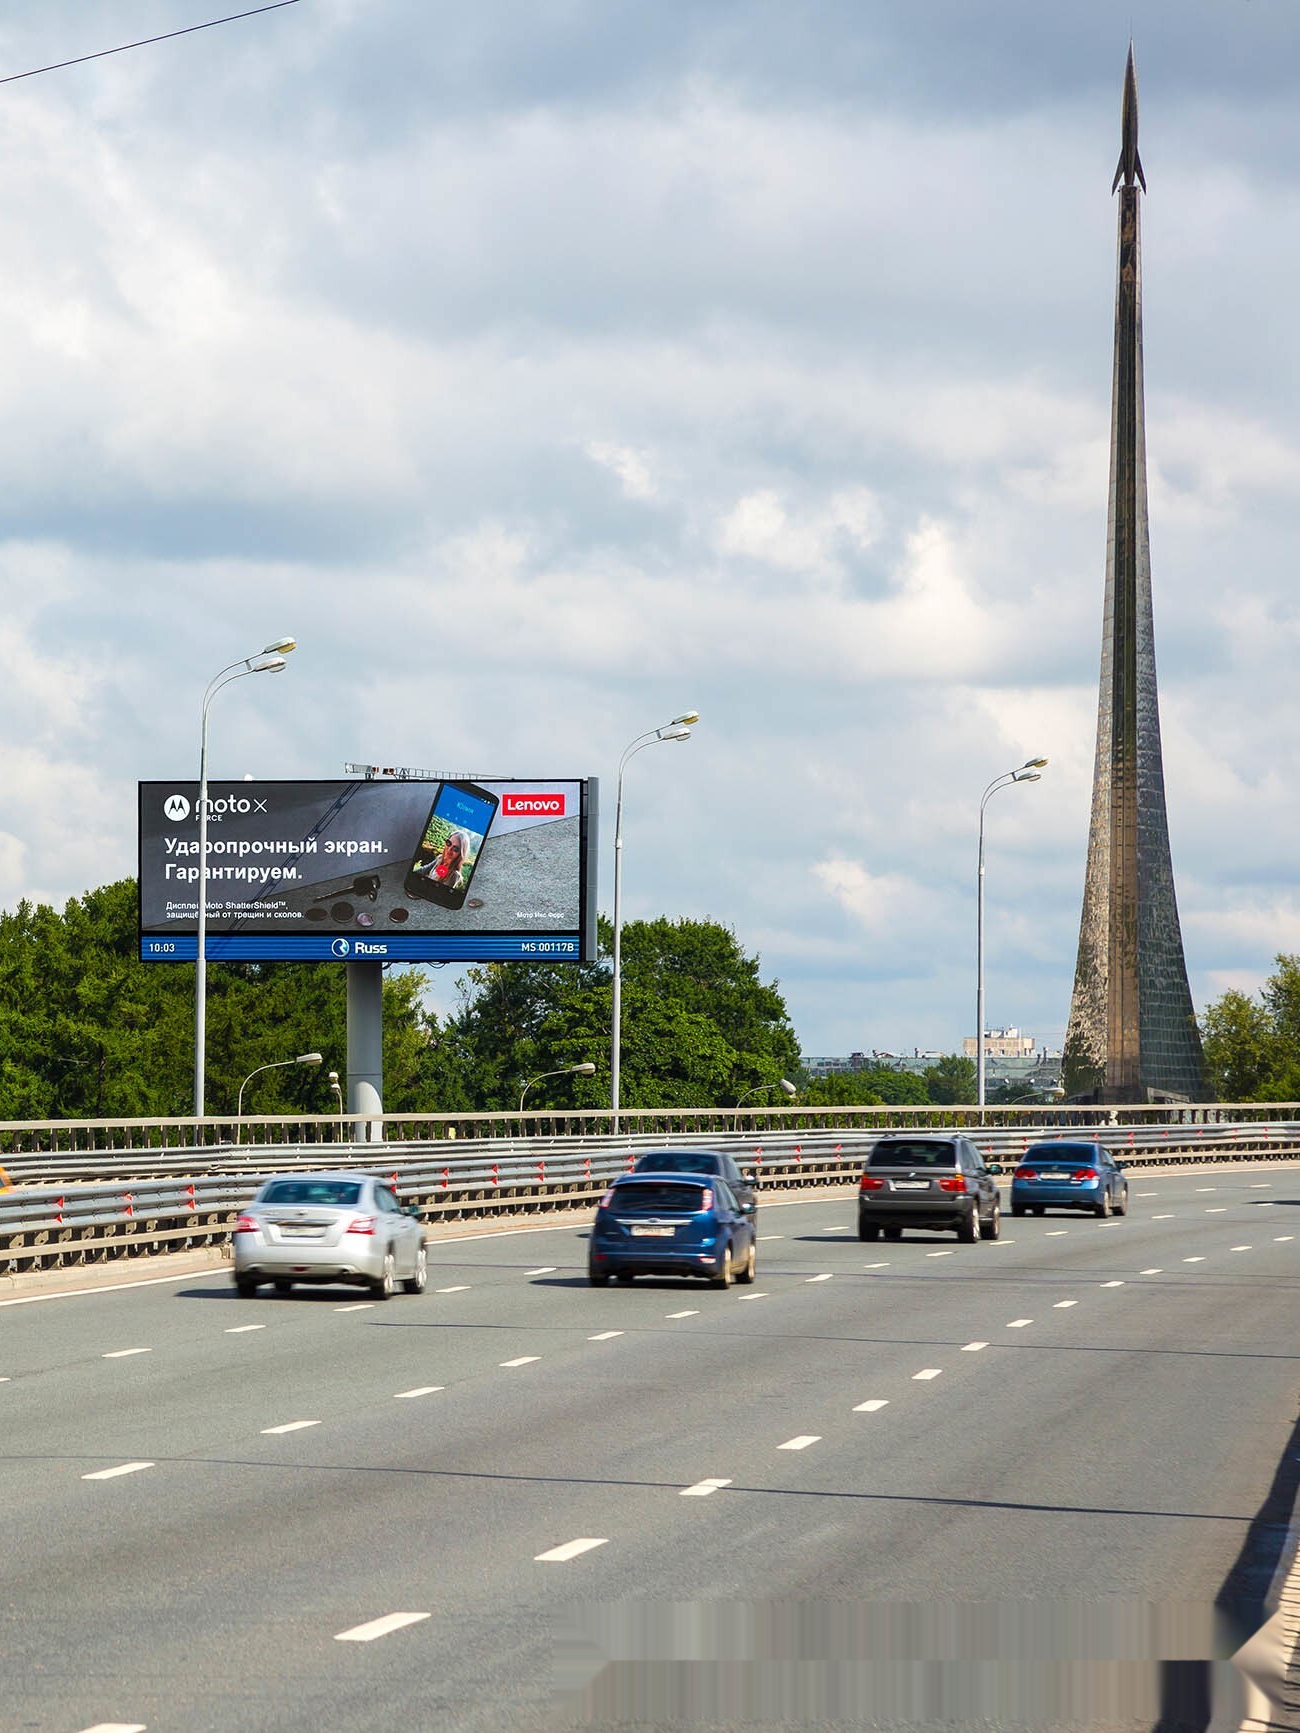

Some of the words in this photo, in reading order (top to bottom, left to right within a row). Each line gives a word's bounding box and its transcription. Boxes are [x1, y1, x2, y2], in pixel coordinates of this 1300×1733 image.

[195, 794, 251, 813] moto
[507, 799, 560, 811] Lenovo
[195, 814, 223, 822] FRCE
[324, 839, 390, 857] экран.
[165, 863, 303, 883] Гарантируем.
[234, 911, 264, 919] трещин
[149, 943, 175, 953] 10:03
[354, 941, 388, 954] Russ
[521, 942, 536, 952] MS
[538, 942, 574, 952] 00117B
